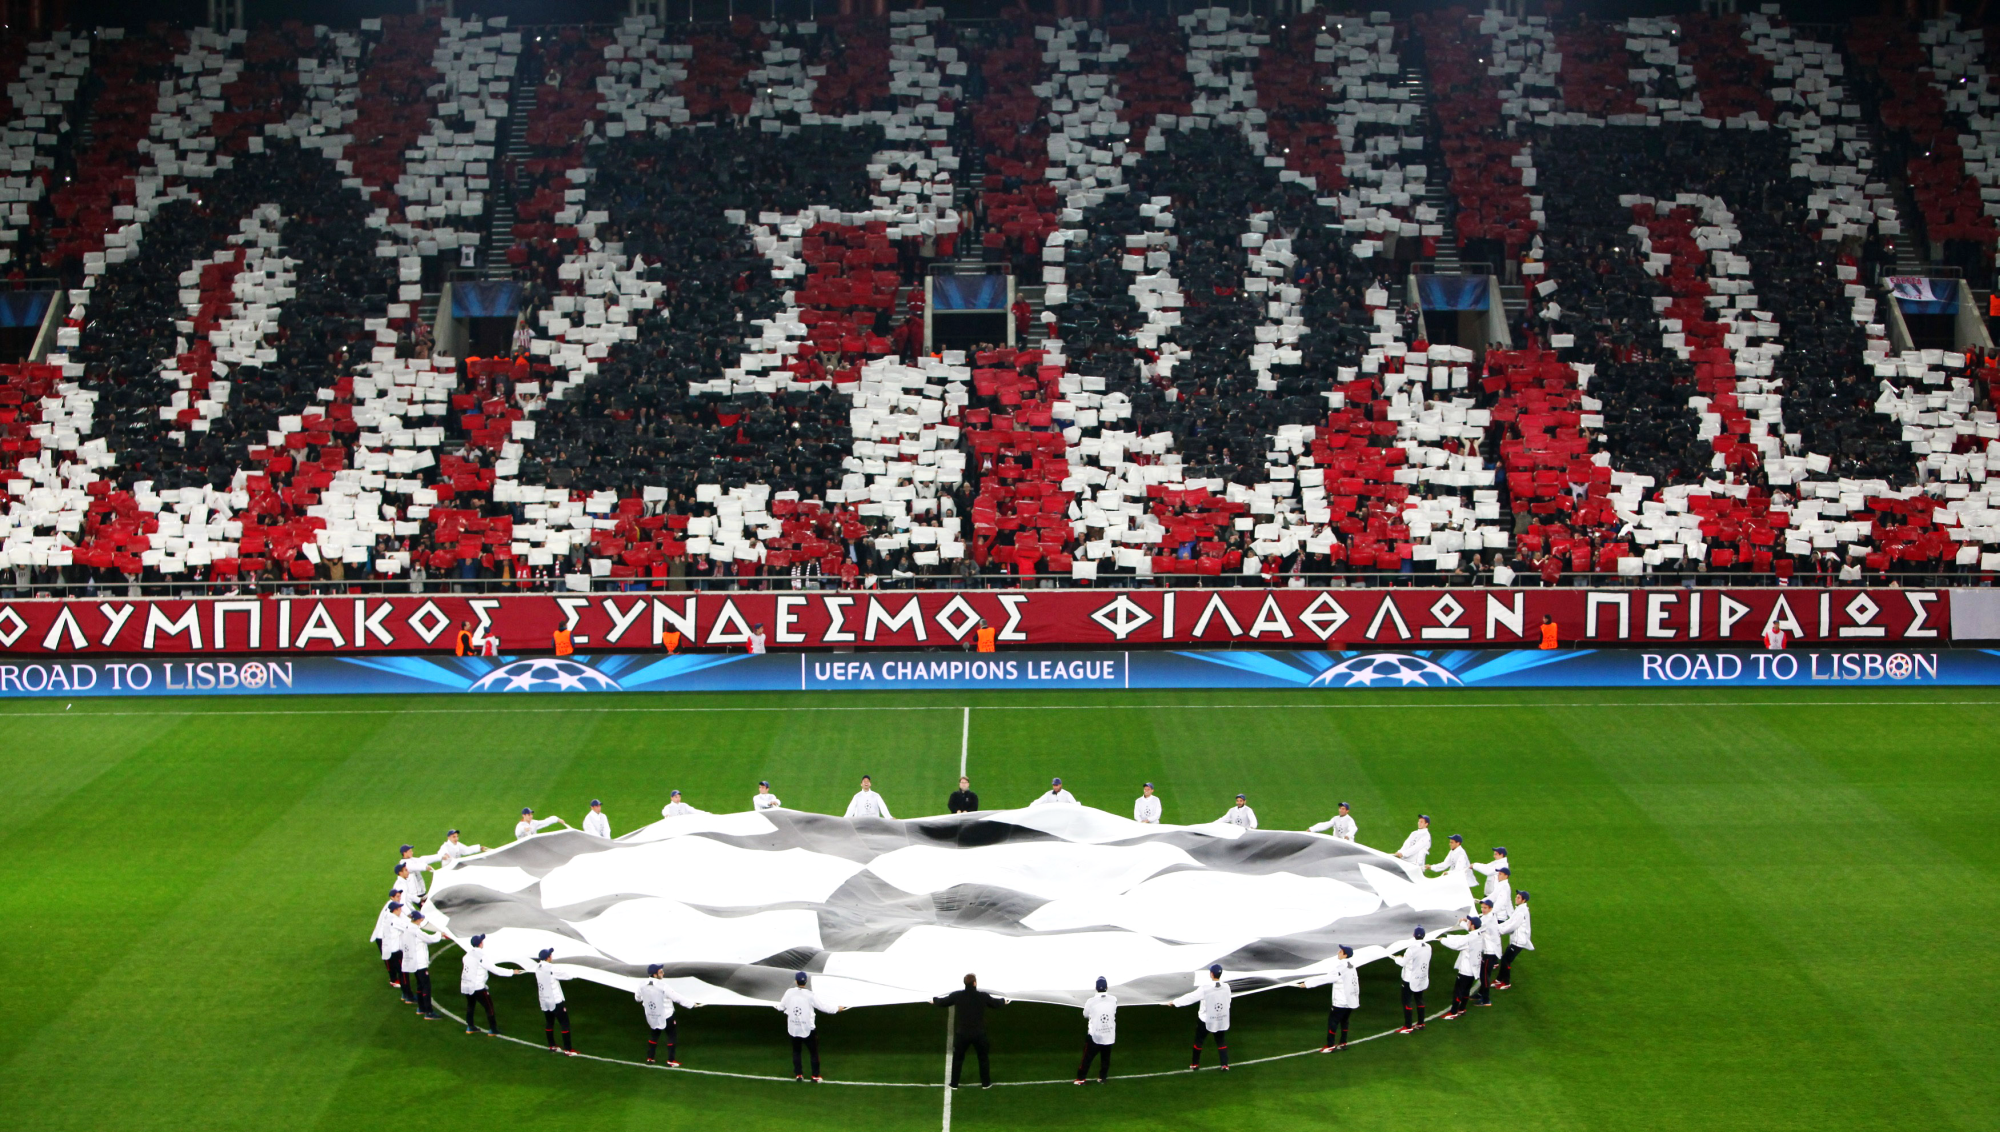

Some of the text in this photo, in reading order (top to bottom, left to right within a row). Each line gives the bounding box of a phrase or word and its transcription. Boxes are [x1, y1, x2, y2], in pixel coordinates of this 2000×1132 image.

[0, 592, 1938, 650] ΟΛΥΜΠΙΑΚΟΣ ΣΥΝΔΕΣΜΟΣ ΦΙΛΑΘΛΩΝ ΠΕΙΡΑΙΩΣ
[1, 661, 293, 691] ROAD TO LISBON
[815, 660, 1115, 681] UEFA CHAMPIONS LEAGUE
[1643, 652, 1938, 681] ROAD TO LISBON
